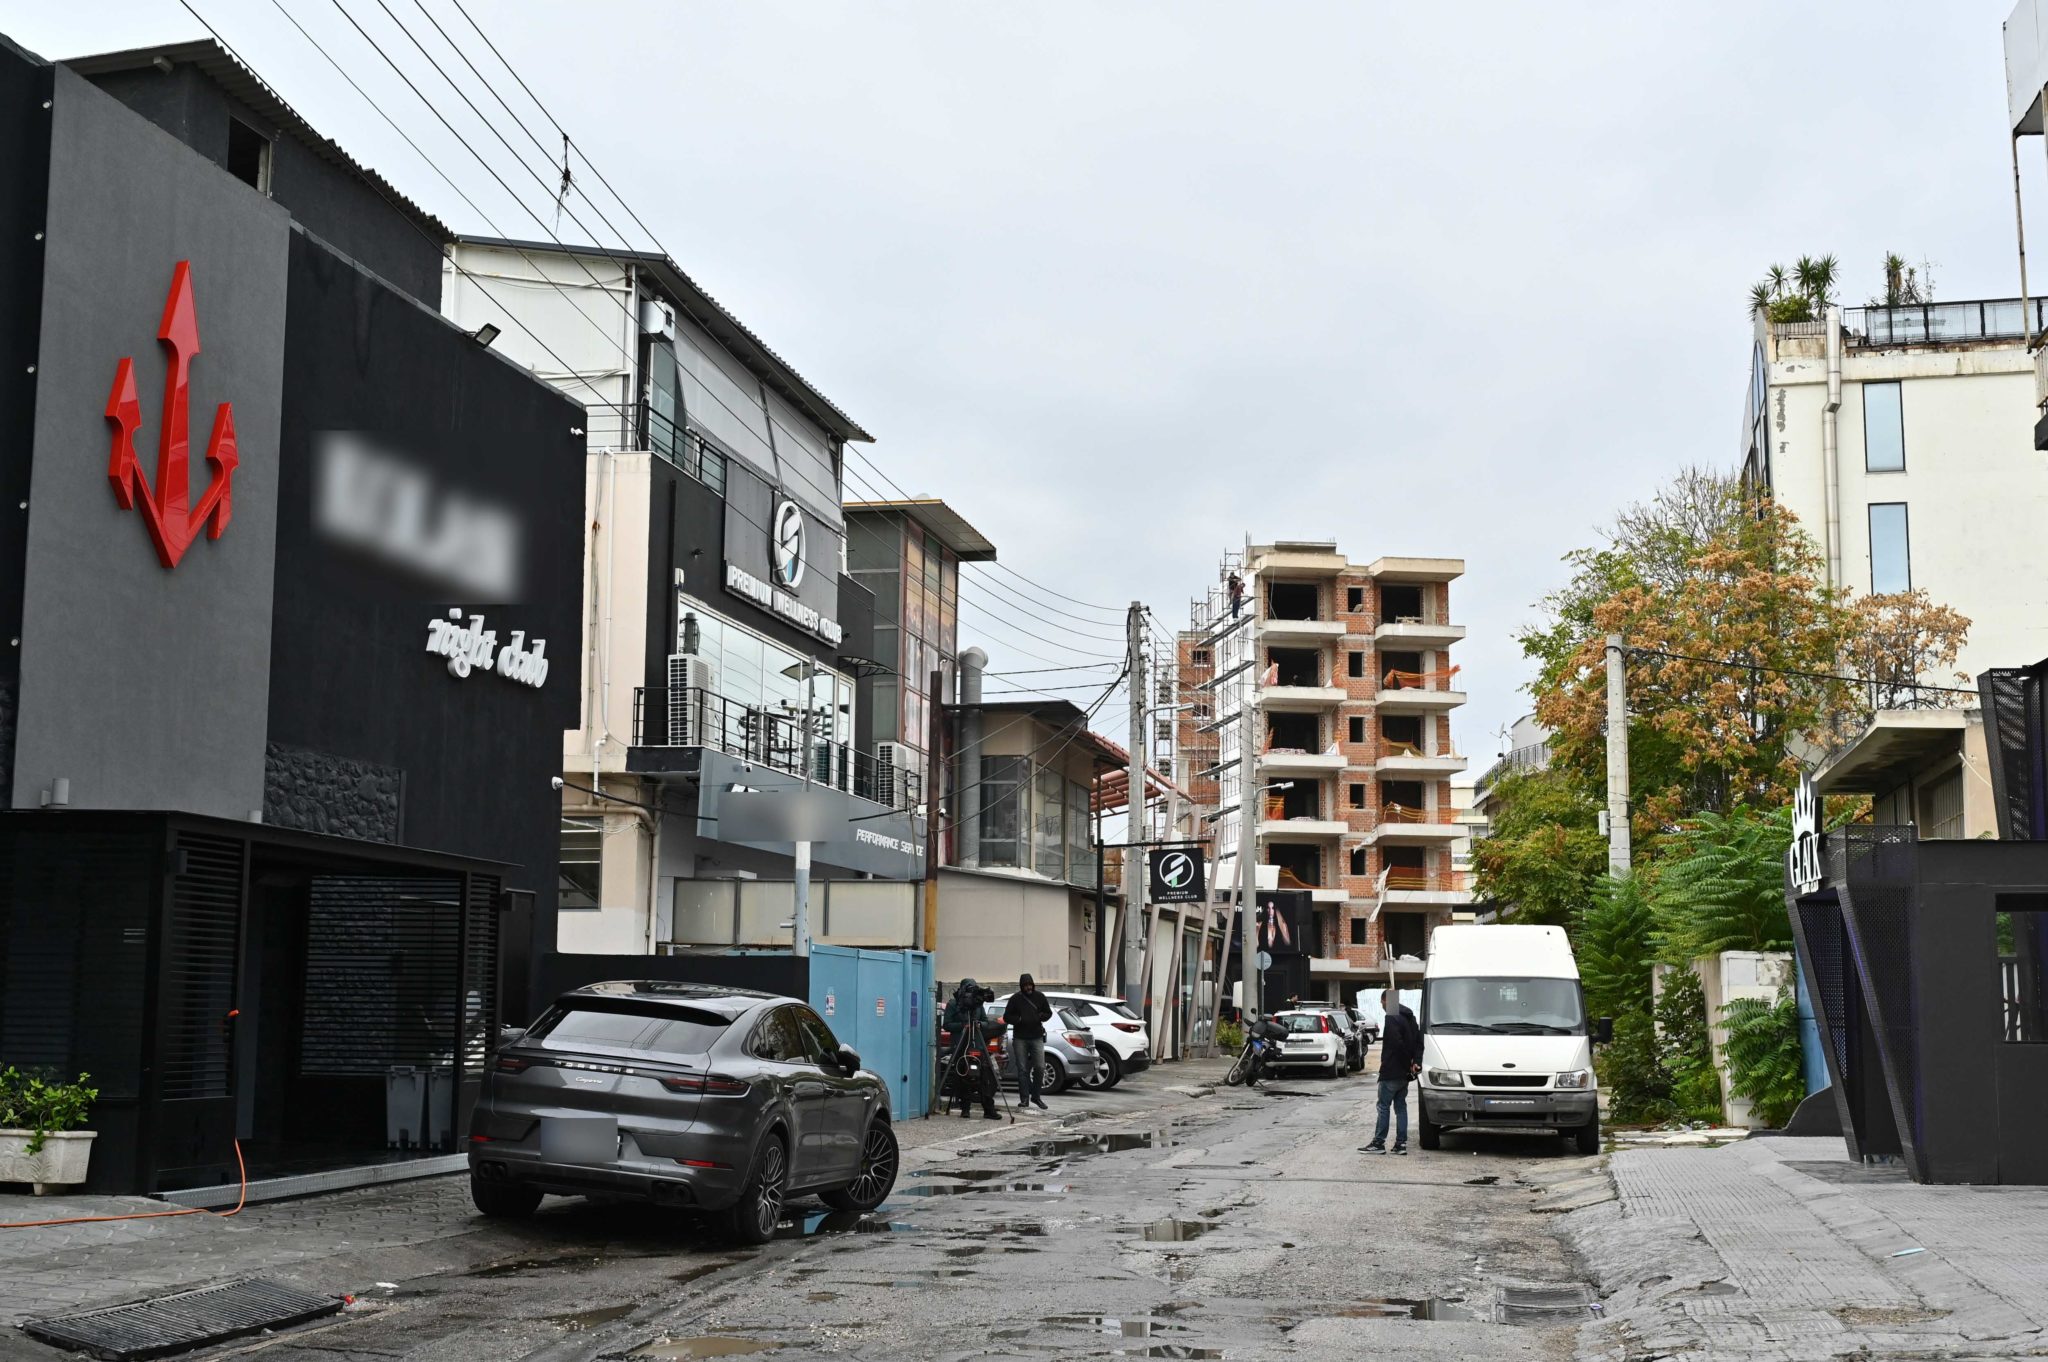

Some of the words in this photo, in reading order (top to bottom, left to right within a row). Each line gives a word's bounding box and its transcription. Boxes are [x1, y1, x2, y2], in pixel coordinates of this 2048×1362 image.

[726, 565, 773, 607] PREMIUM
[773, 590, 819, 632] WELLNESS
[819, 617, 843, 644] CLUB
[426, 608, 498, 678] night
[497, 630, 549, 688] club
[856, 828, 900, 850] PERFORMANCE
[900, 840, 924, 857] SERVCE
